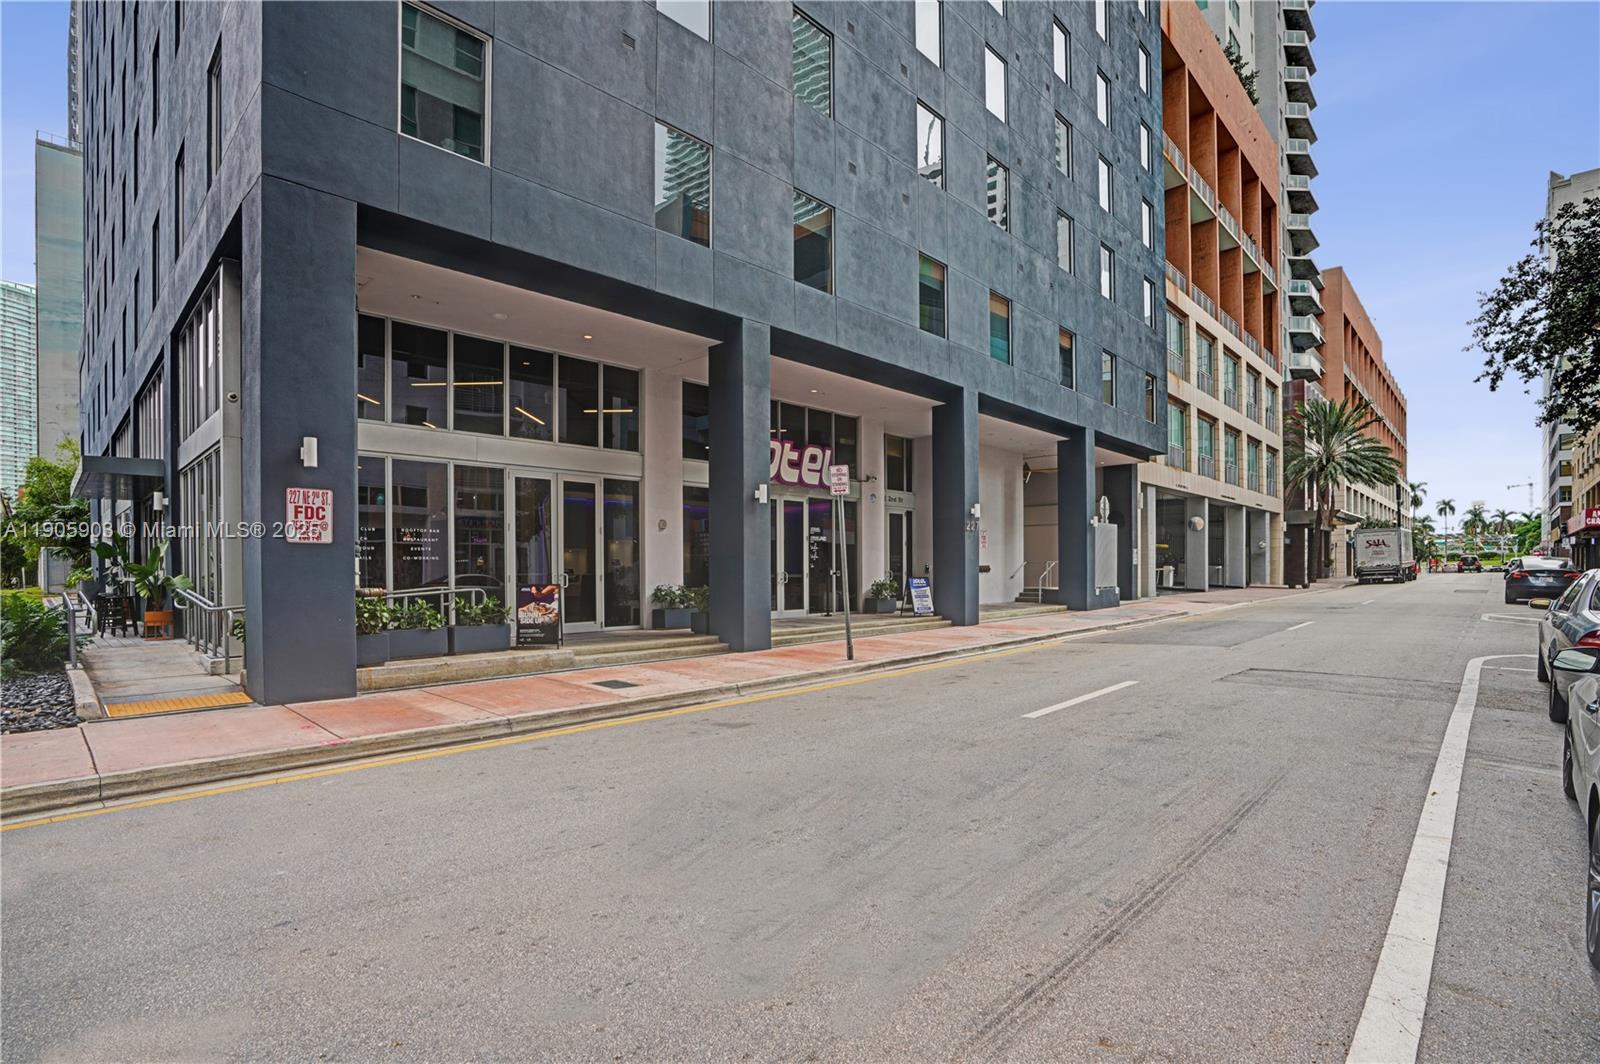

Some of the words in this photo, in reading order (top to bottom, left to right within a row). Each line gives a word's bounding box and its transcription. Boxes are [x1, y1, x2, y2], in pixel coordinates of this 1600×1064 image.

[289, 490, 300, 504] 227
[303, 491, 310, 504] NE
[294, 505, 326, 520] FDC
[966, 520, 980, 531] 227
